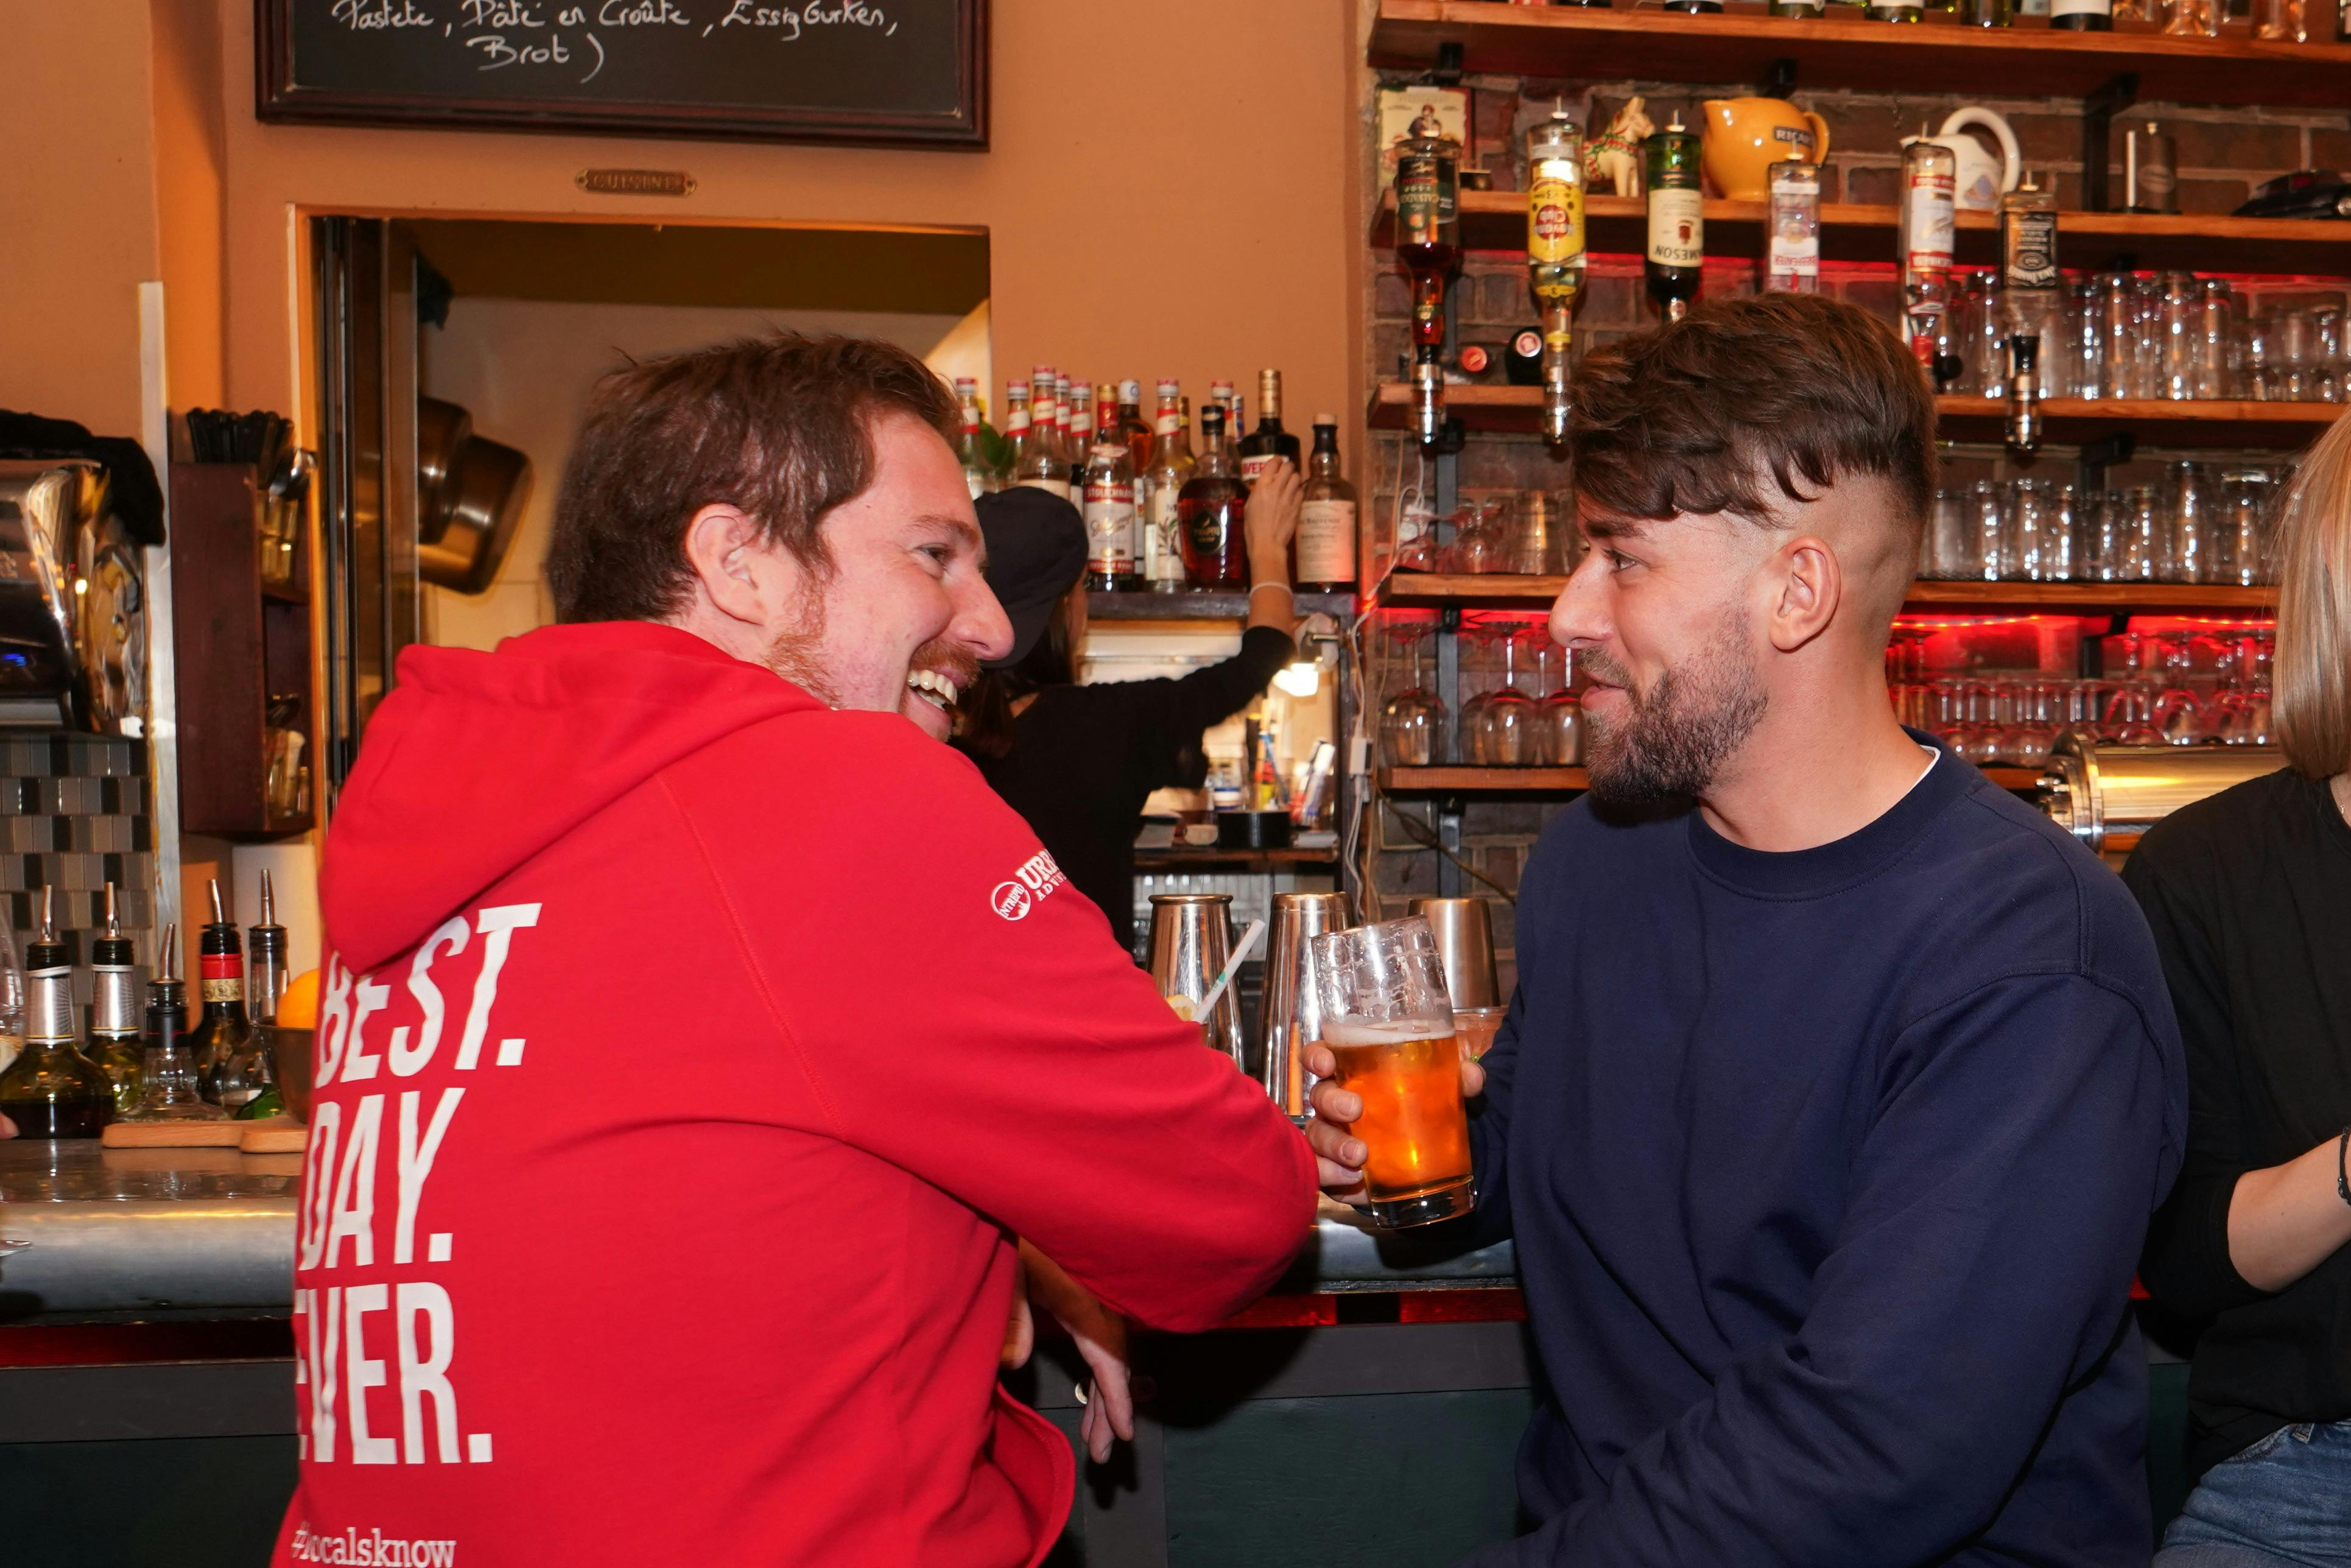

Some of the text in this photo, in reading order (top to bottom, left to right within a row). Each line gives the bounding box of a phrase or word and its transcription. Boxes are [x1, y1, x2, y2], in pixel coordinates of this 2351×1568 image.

[558, 6, 586, 26] en
[315, 902, 543, 1089] BEST.
[298, 1088, 466, 1271] DAY.
